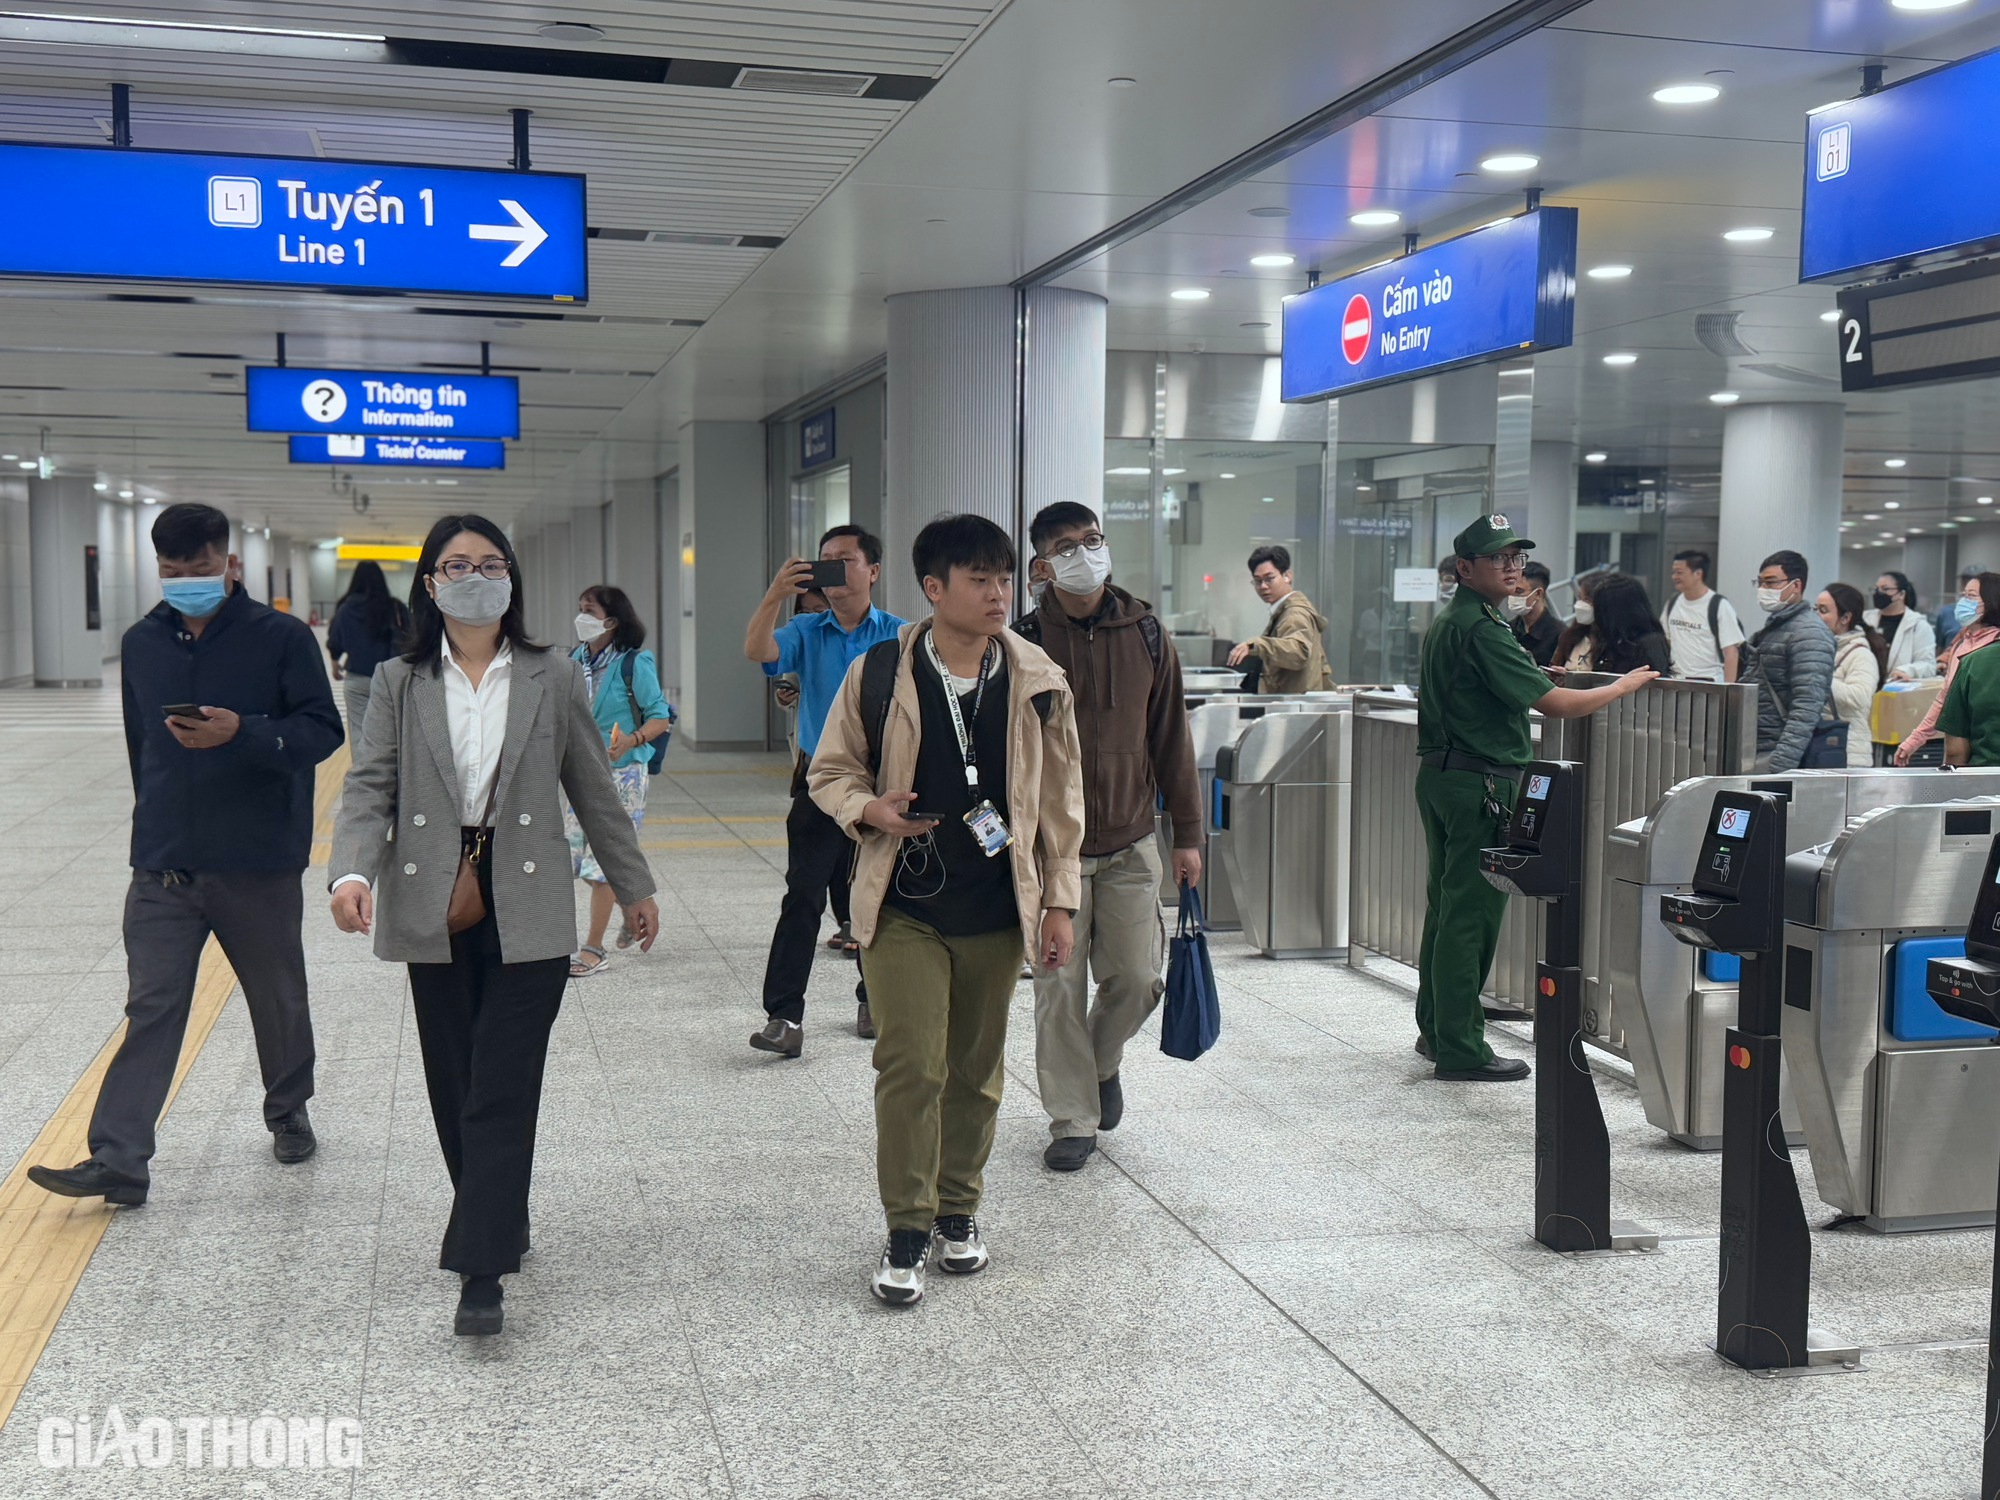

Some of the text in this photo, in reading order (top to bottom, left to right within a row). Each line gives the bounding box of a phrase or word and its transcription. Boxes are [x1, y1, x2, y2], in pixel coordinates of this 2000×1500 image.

[1828, 131, 1840, 148] L1
[1826, 149, 1840, 172] 01
[224, 192, 247, 212] L1
[277, 179, 434, 231] Tuyến 1
[278, 233, 365, 266] Line 1
[1383, 268, 1452, 318] Cấm vào
[1380, 324, 1432, 356] No Entry
[1843, 318, 1863, 363] 2
[361, 380, 467, 411] Thông tin
[362, 408, 454, 428] Information
[376, 443, 467, 461] Ticket Counter
[1939, 973, 1948, 983] Tap
